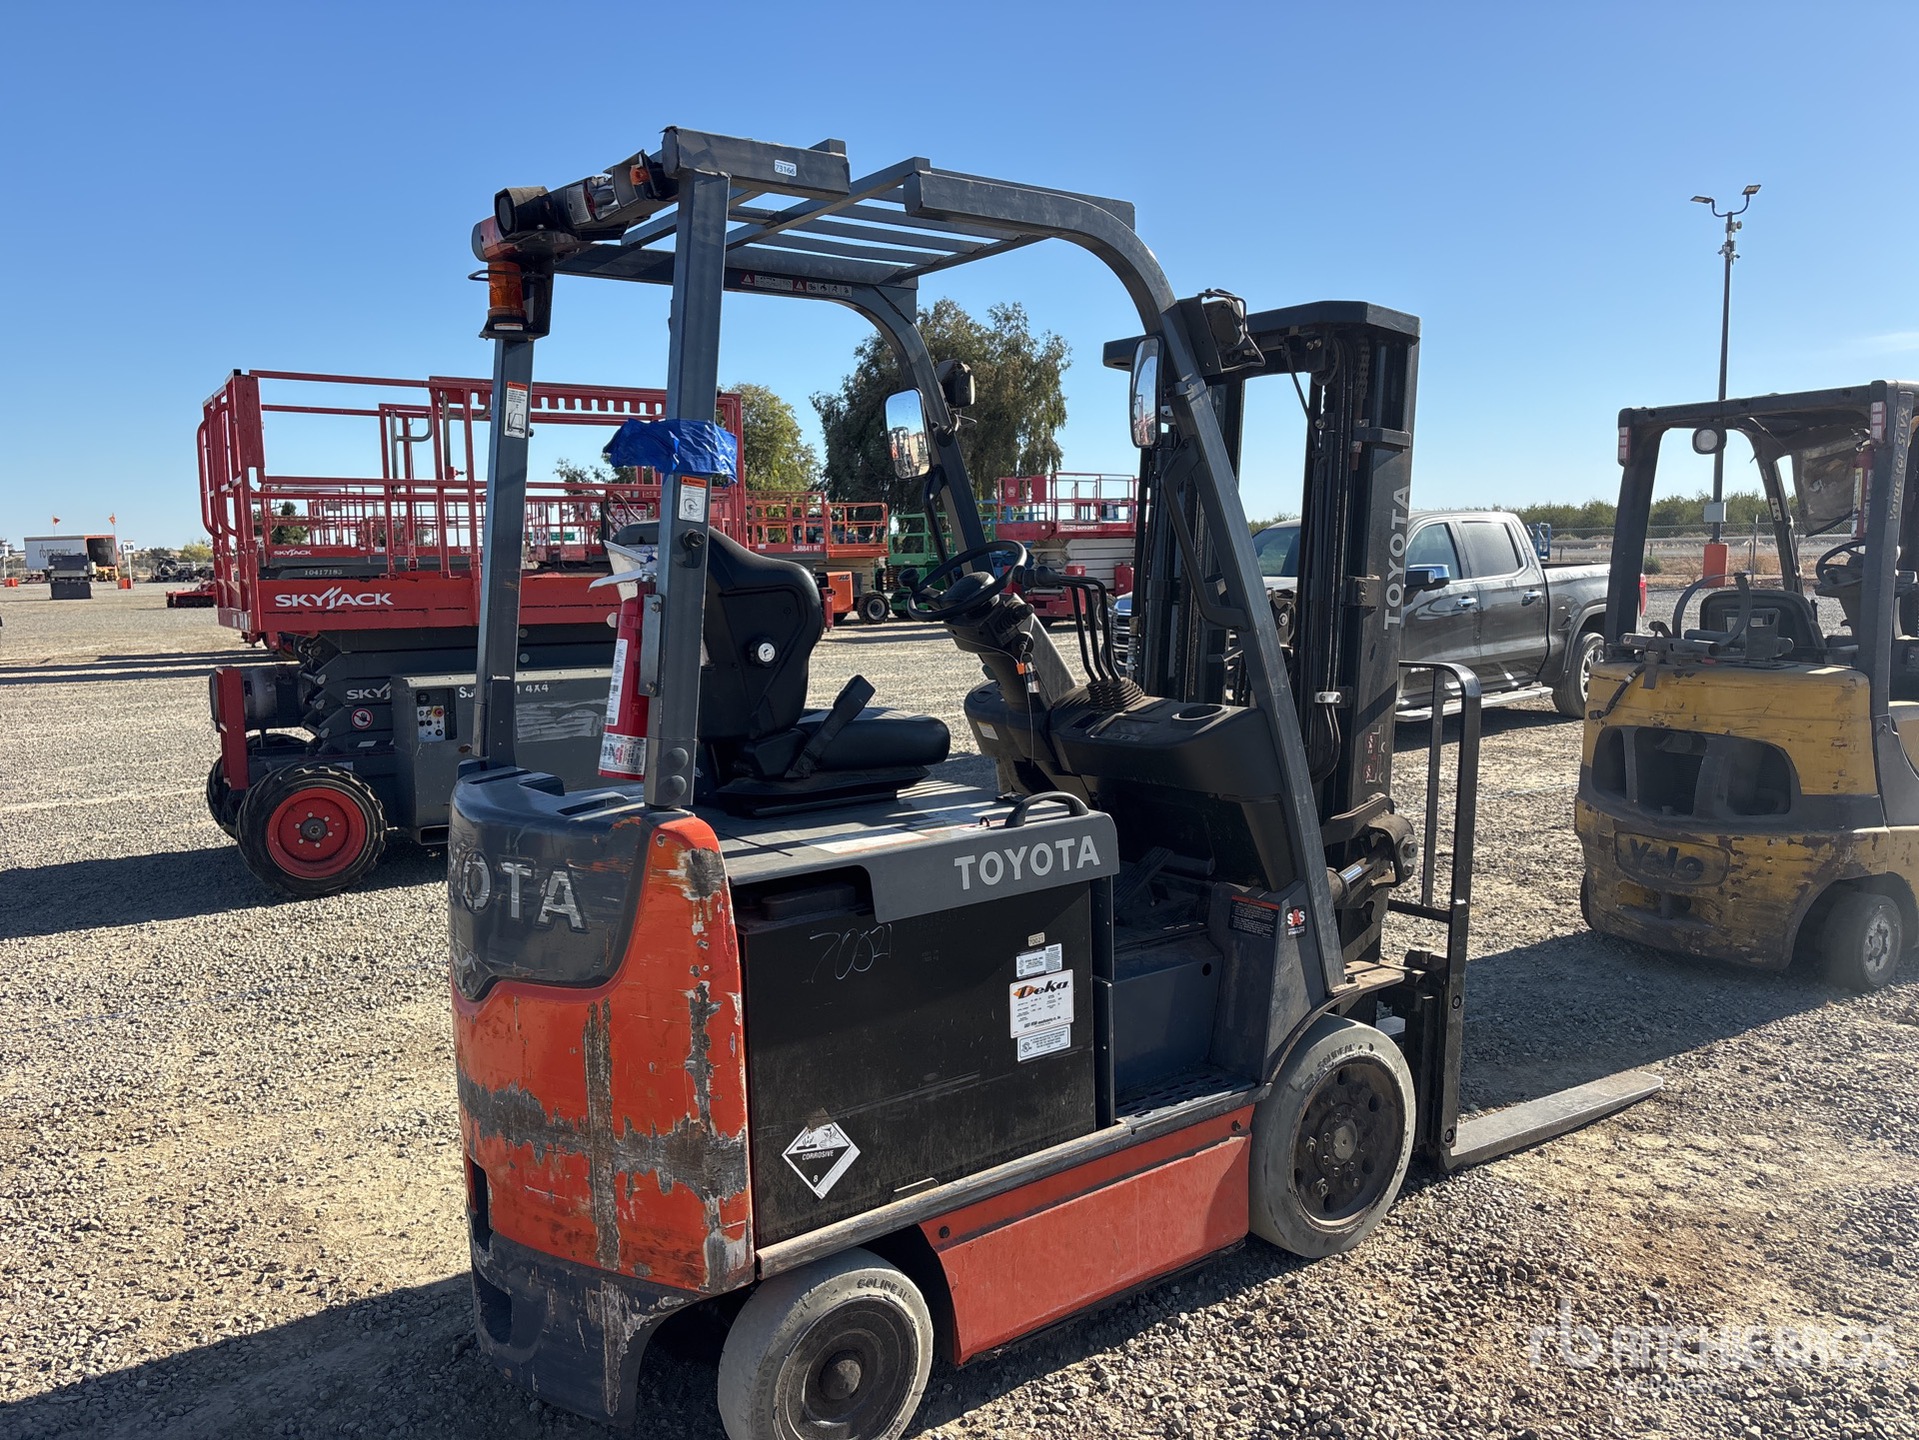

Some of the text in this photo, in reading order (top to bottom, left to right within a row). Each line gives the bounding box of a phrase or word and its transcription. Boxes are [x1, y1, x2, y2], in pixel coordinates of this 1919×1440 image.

[775, 164, 796, 175] 73166
[1889, 451, 1904, 520] Veractor
[273, 548, 312, 556] SKYJACK
[1383, 485, 1409, 630] TOYOTA
[275, 586, 394, 610] SKYJACK
[346, 682, 392, 700] SKYJ
[954, 835, 1101, 890] TOYOTA
[450, 845, 588, 930] OTA
[1287, 909, 1306, 927] SAS
[1014, 980, 1069, 999] Deka
[801, 1149, 834, 1161] CORROSIVE
[813, 1174, 819, 1183] 8
